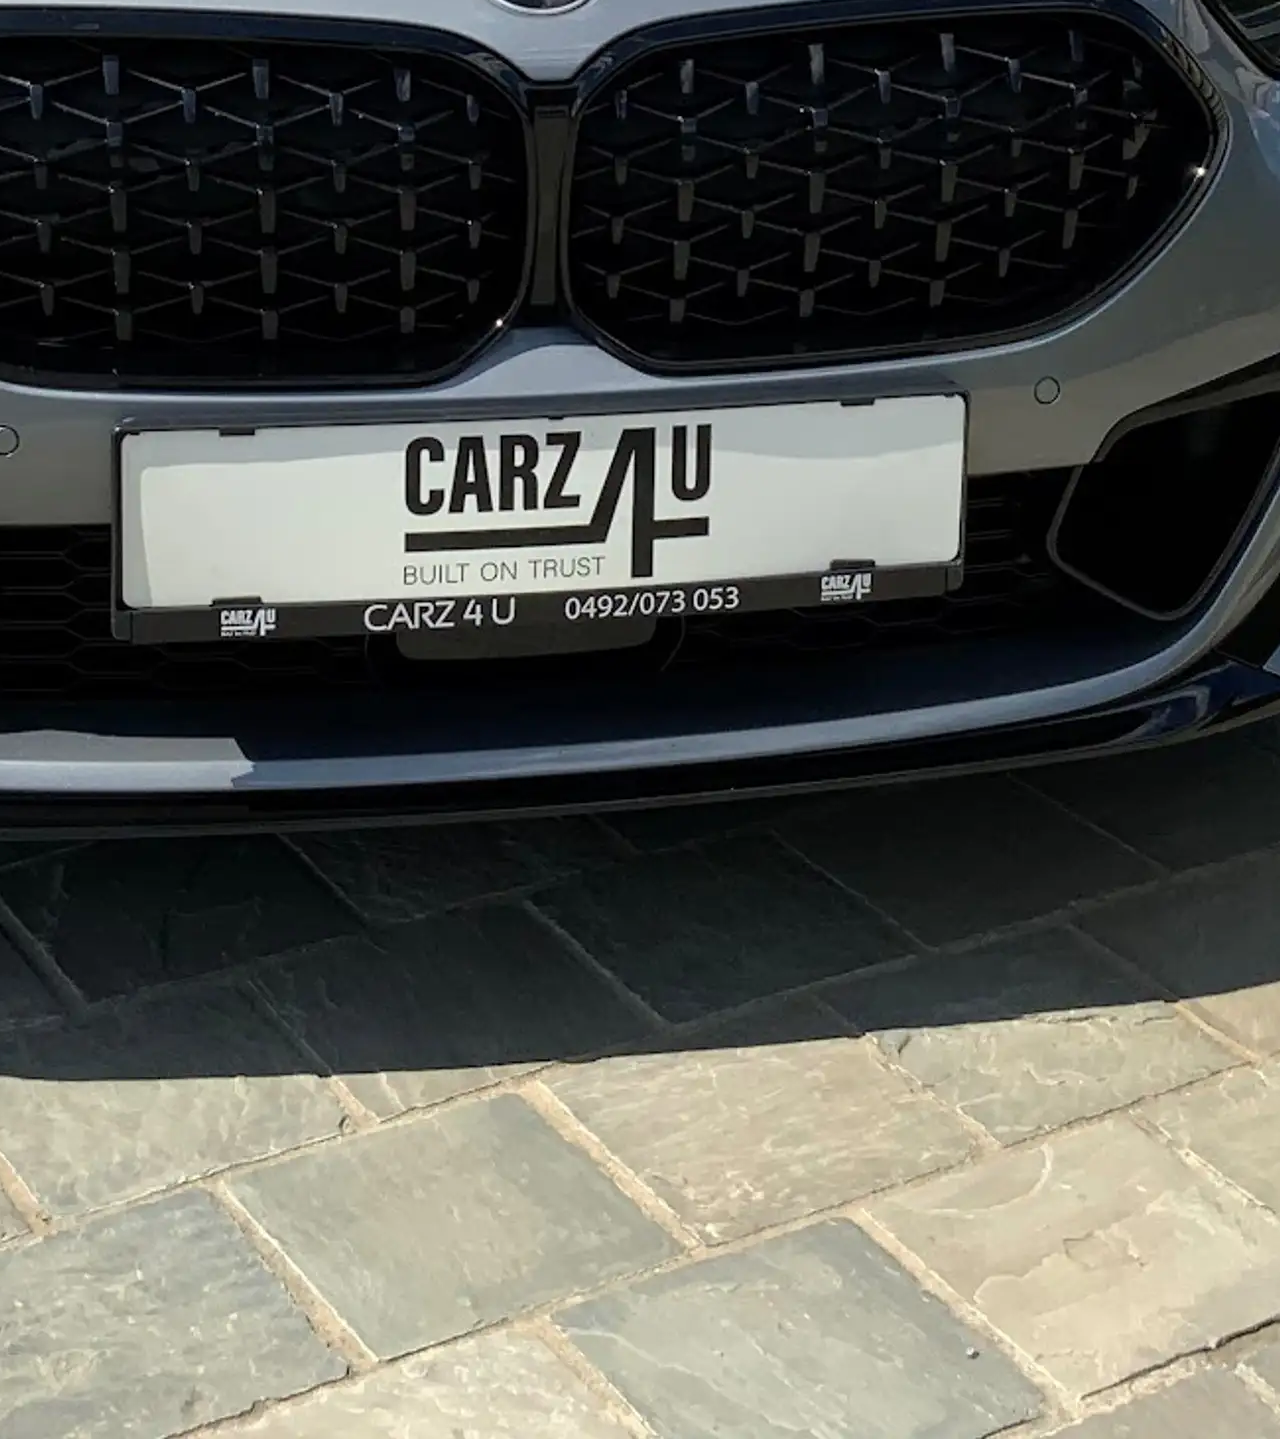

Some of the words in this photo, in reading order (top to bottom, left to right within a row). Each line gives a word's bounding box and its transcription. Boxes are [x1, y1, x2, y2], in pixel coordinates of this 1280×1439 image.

[403, 562, 471, 586] BUILT
[480, 560, 517, 582] ON
[527, 556, 606, 580] TRUST
[363, 600, 456, 631] CARZ
[463, 598, 483, 627] 4
[491, 596, 516, 625] U
[564, 589, 686, 621] 0492/073
[692, 586, 740, 611] 053
